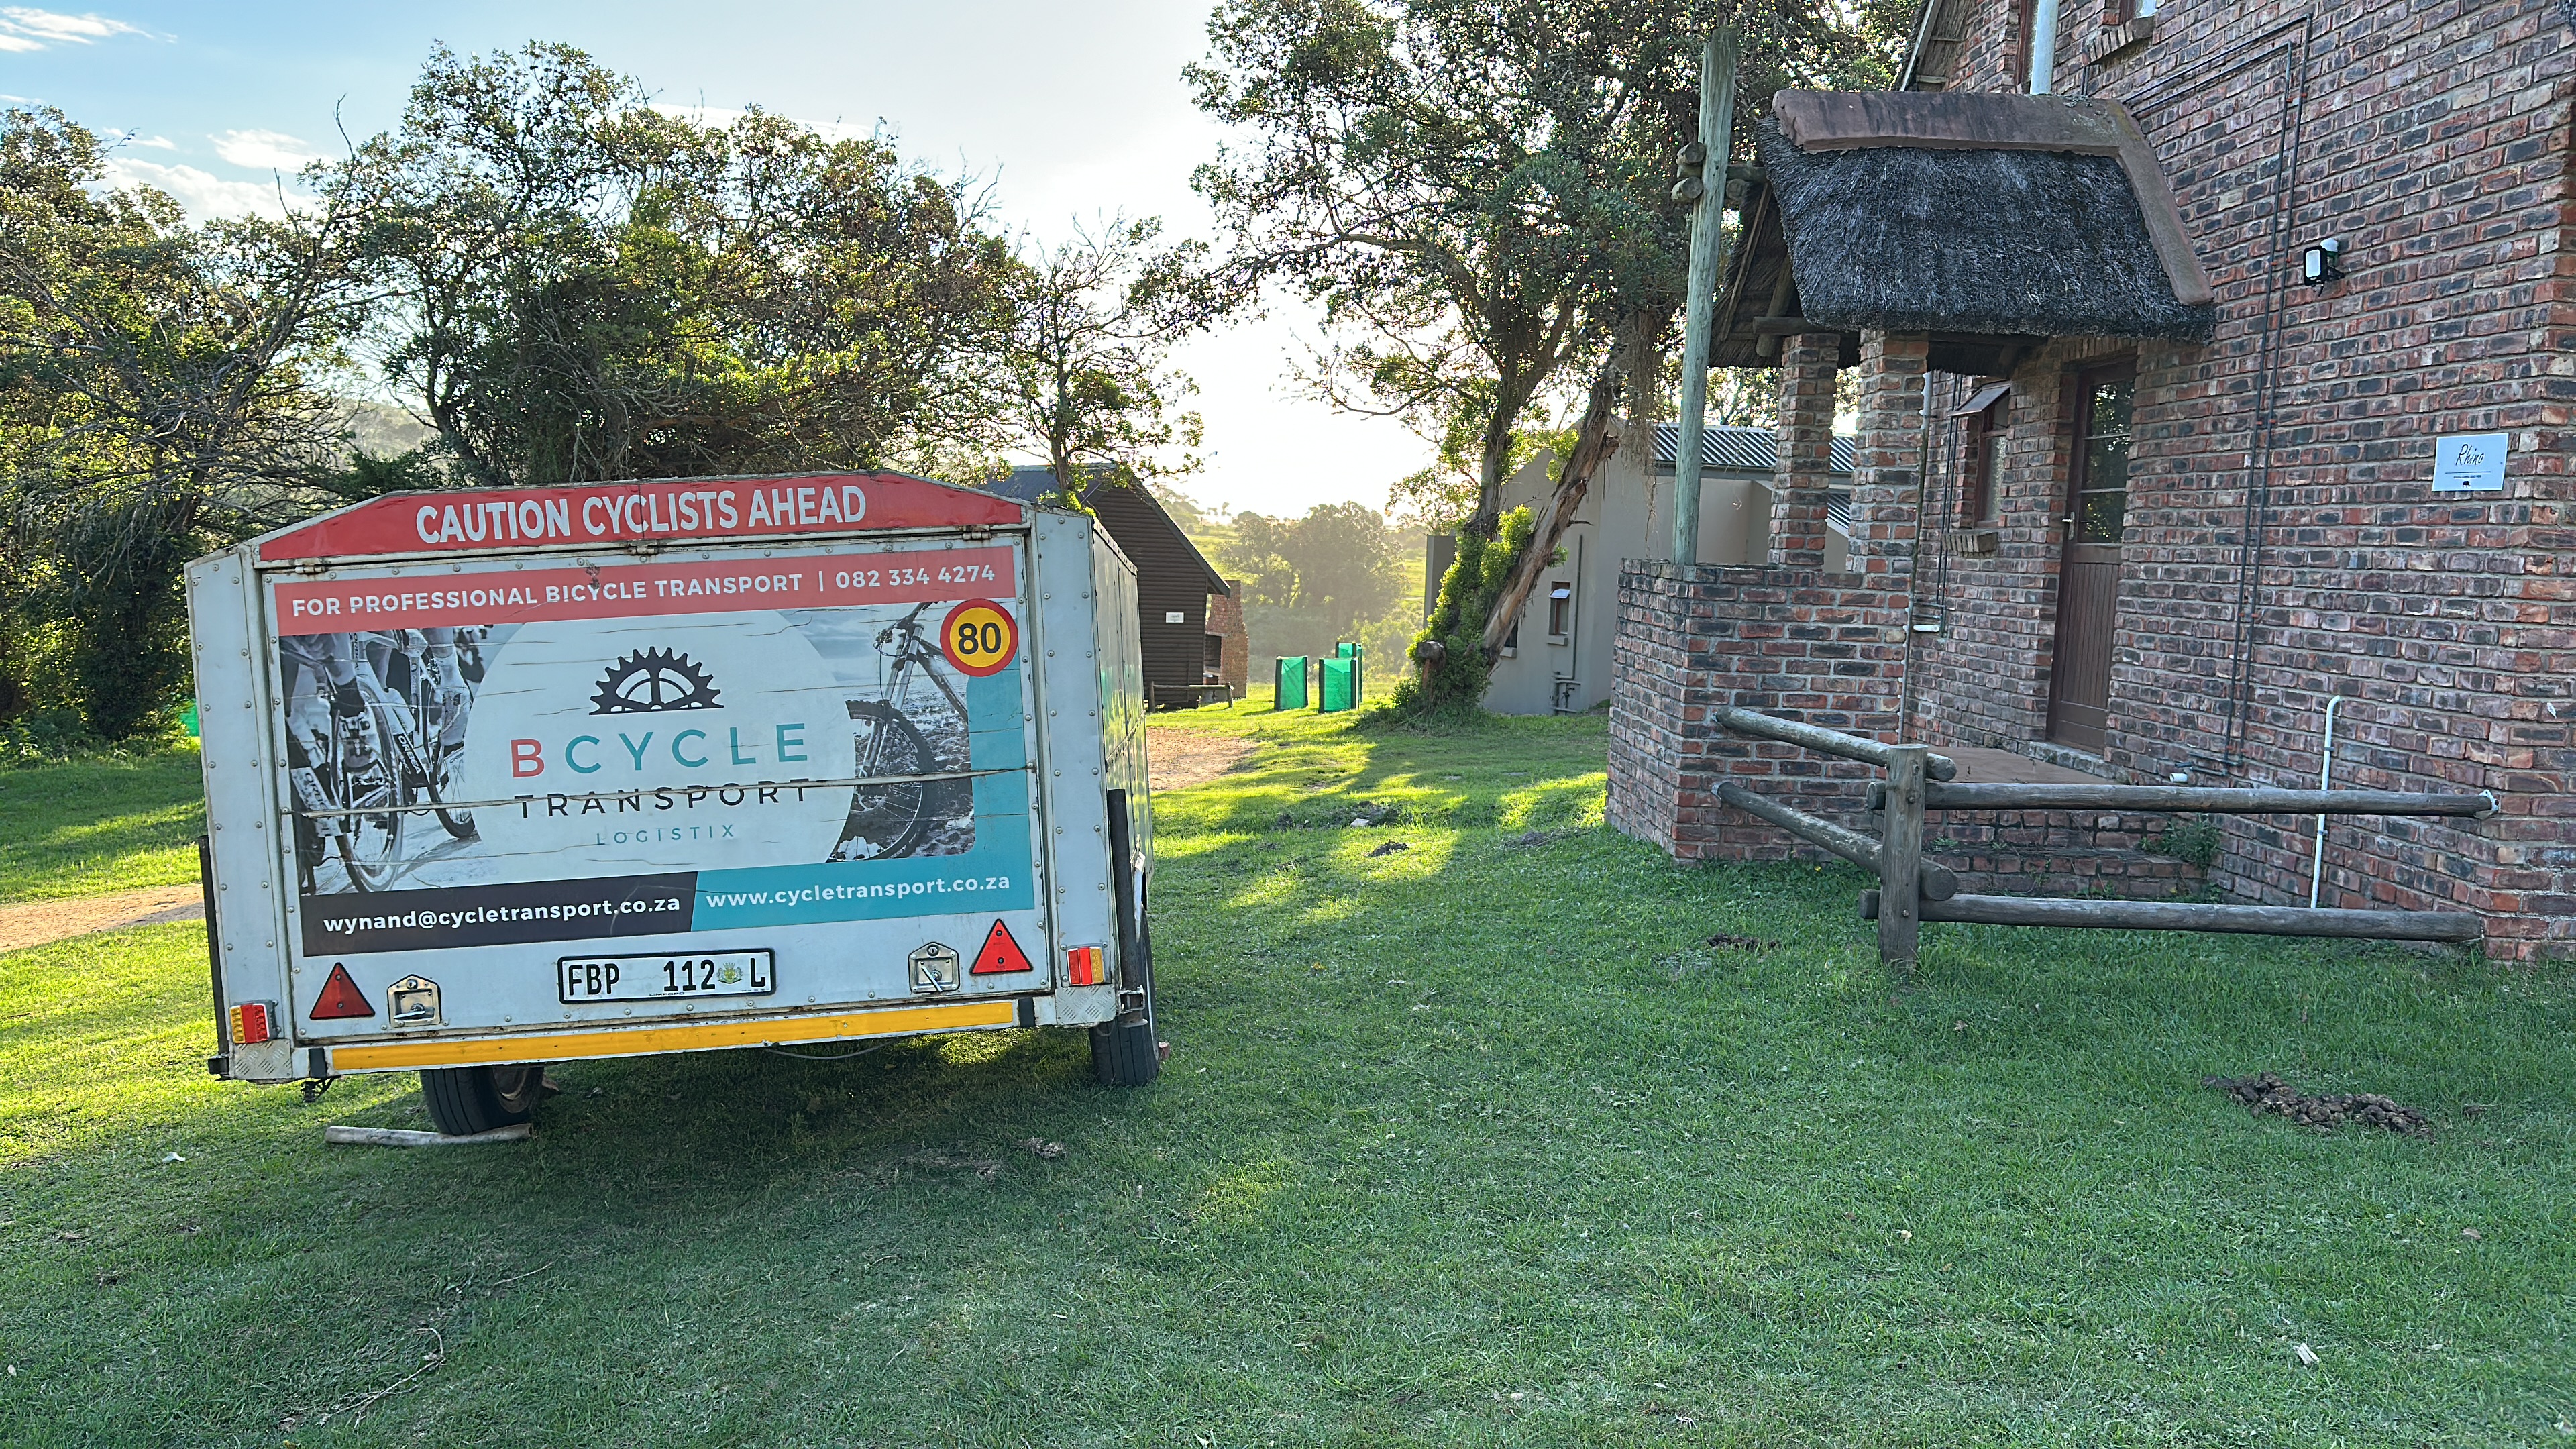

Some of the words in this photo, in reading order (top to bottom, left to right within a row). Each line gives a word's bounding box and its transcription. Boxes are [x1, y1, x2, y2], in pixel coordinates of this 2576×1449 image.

[2455, 443, 2485, 466] Rhino
[416, 498, 570, 544] CAUTION
[582, 490, 739, 535] CYCLISTS
[748, 485, 867, 527] AHEAD
[292, 598, 341, 616] FOR
[350, 587, 537, 614] PROFESSIONAL
[545, 581, 647, 603] BICYCLE
[654, 574, 802, 597] TRANSPORT
[835, 570, 881, 588] 082
[889, 568, 930, 586] 334
[938, 564, 995, 583] 4274
[958, 622, 1002, 655] 80
[398, 735, 421, 775] ORBEA
[511, 723, 808, 779] BCYCLE
[515, 778, 810, 819] TRANSPORT
[596, 824, 735, 845] LOGISTIX
[706, 876, 1010, 908] www.cycletransport.co.za
[323, 896, 680, 935] wynand@cycletransport.co.za
[568, 963, 620, 996] FBP
[663, 959, 716, 992] 112
[750, 957, 766, 987] L
